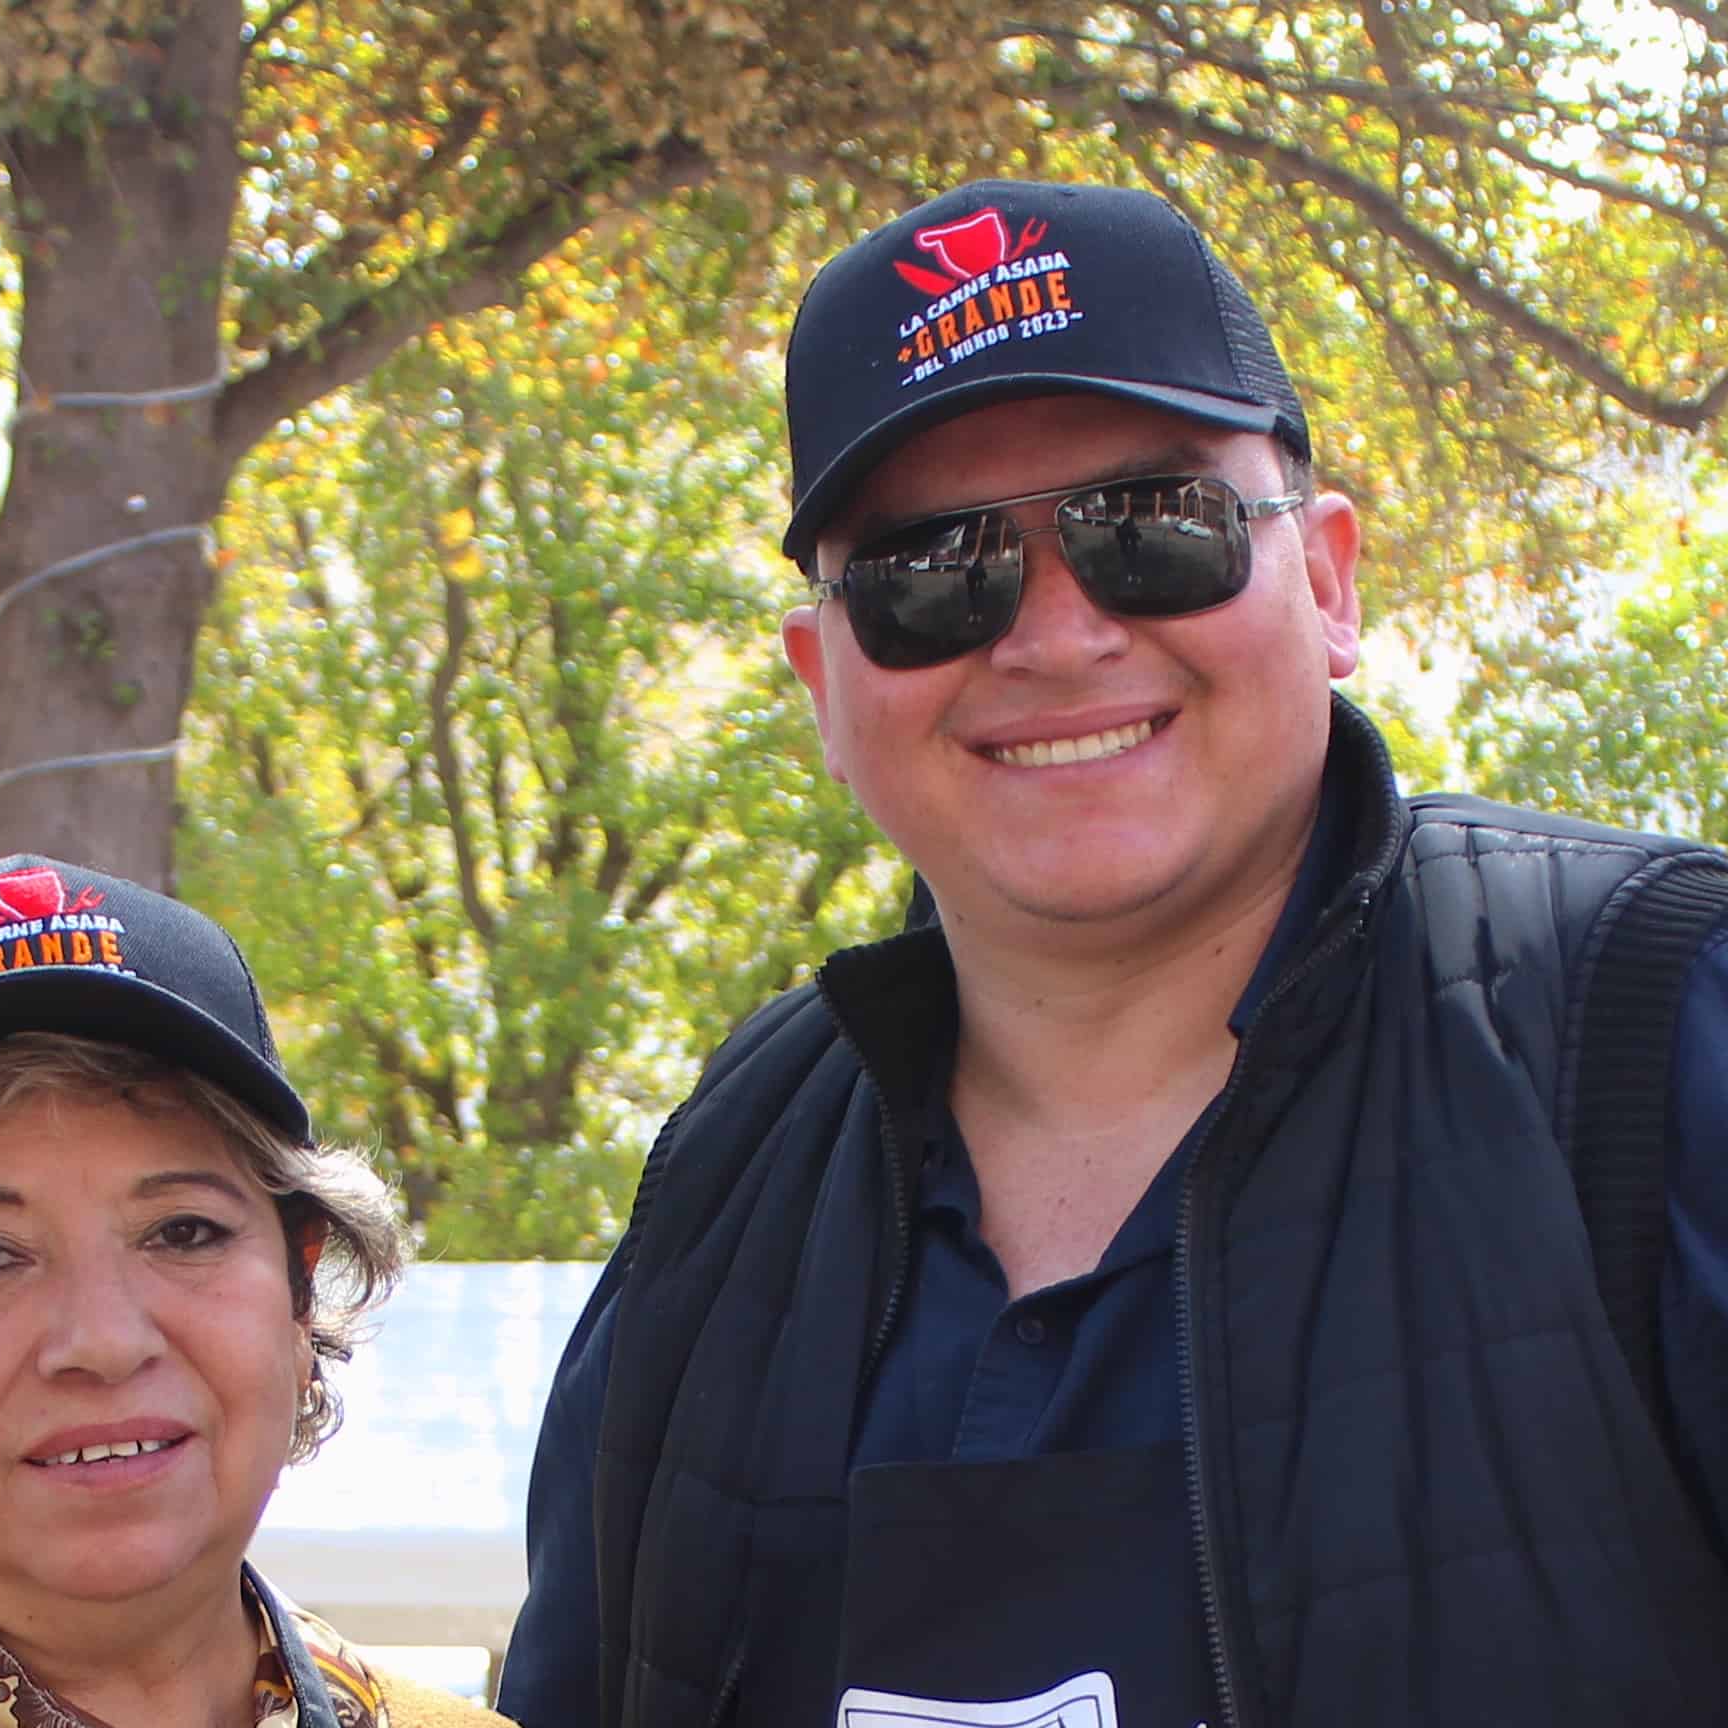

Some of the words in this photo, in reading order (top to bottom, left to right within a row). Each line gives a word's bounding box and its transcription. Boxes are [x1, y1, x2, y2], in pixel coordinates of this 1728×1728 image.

[899, 315, 924, 338] LA
[927, 273, 991, 320] CARNE
[995, 252, 1072, 282] ASADA
[950, 324, 1010, 364] MUNDO
[50, 914, 125, 934] ASADA
